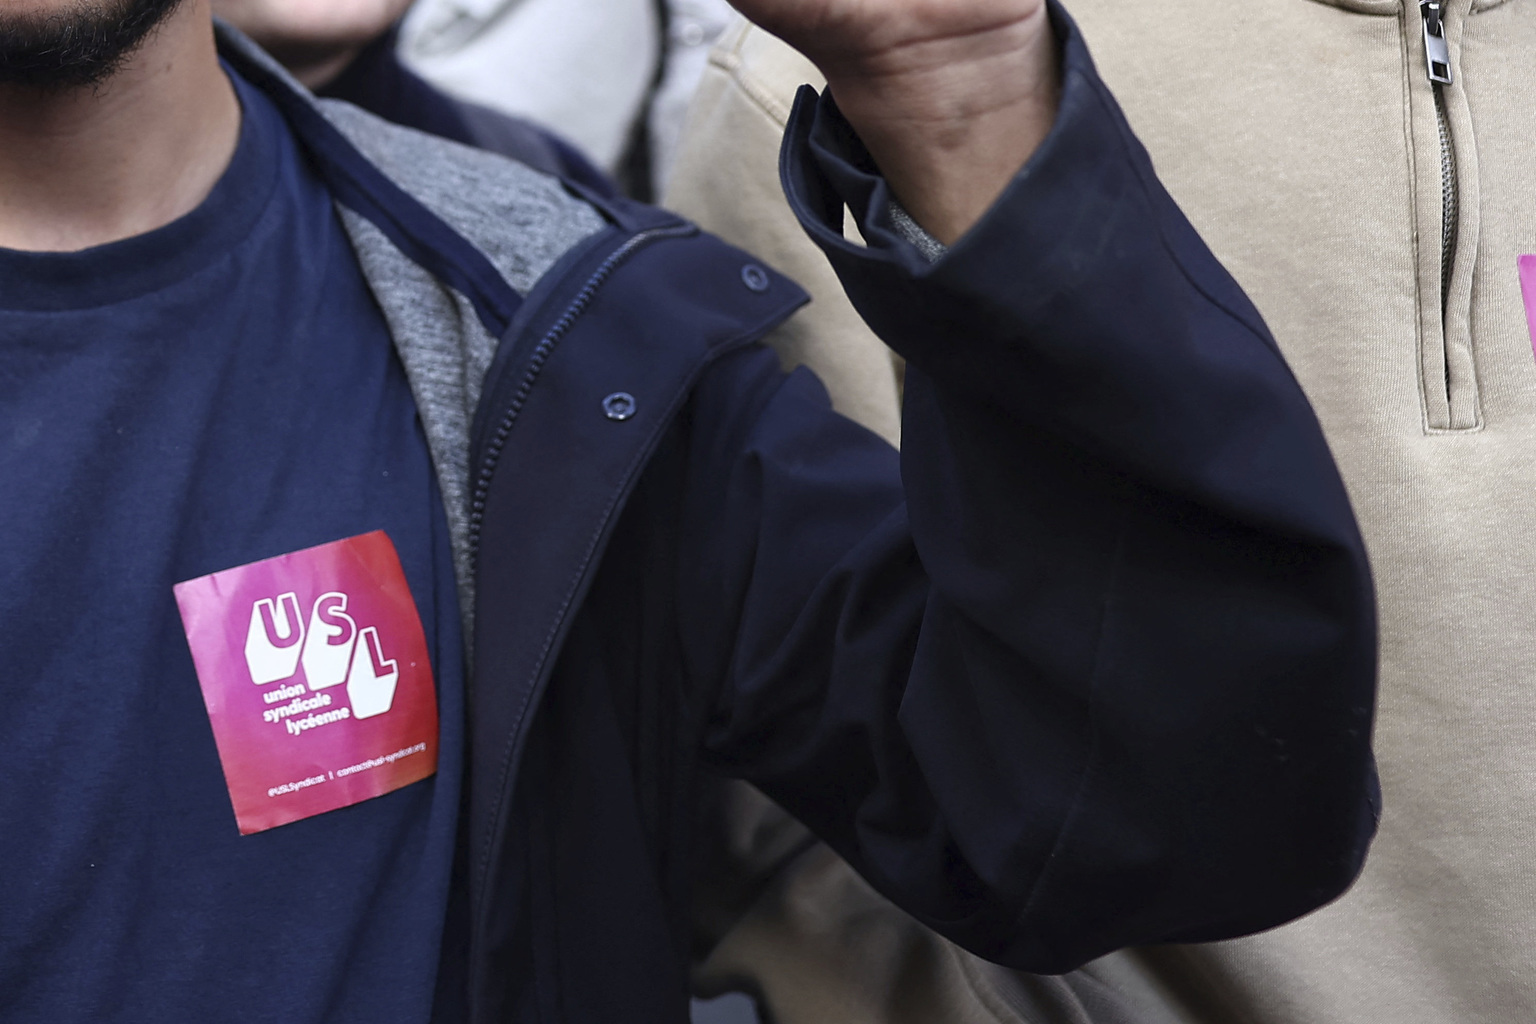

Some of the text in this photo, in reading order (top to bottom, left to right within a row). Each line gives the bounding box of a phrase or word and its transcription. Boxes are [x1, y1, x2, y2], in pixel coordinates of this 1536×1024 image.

[248, 591, 399, 698] USL
[263, 683, 306, 704] union
[263, 692, 332, 723] syndicale
[285, 707, 350, 736] lycéenne
